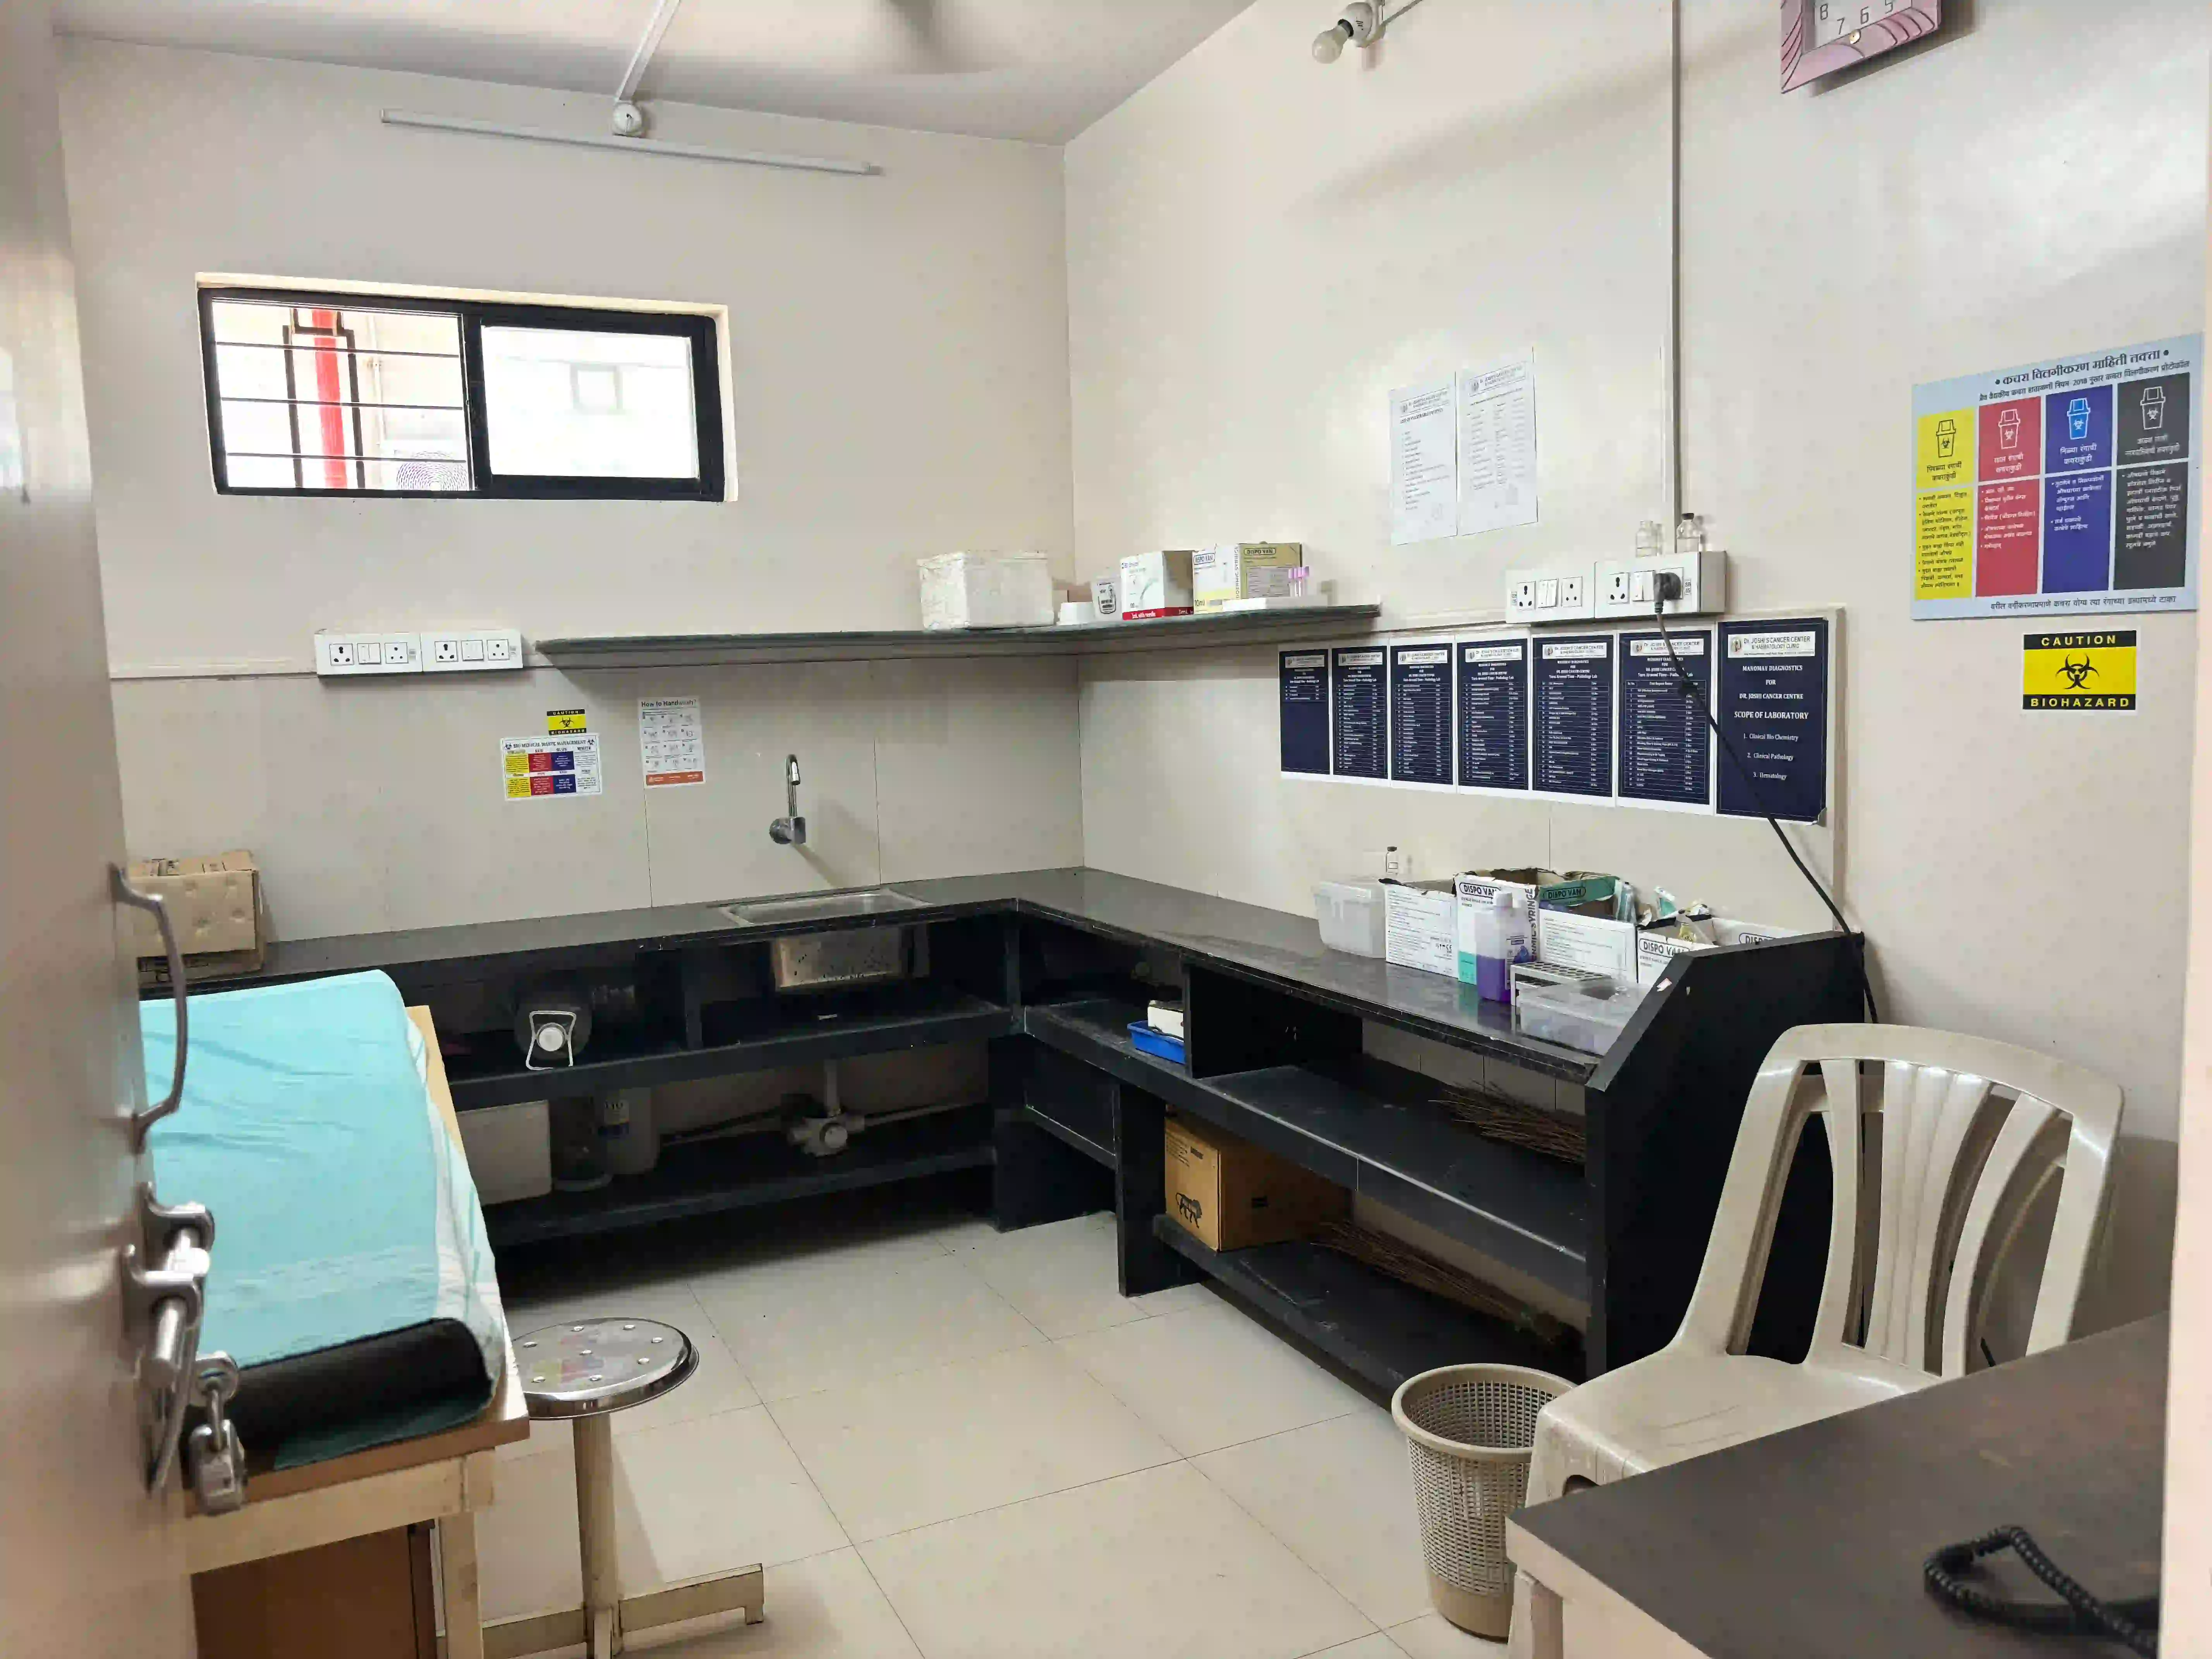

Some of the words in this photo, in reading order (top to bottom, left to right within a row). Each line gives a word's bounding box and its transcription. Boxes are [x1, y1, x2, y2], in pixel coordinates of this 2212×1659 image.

[1820, 3, 1828, 20] 8
[1860, 6, 1869, 24] 6
[1837, 17, 1845, 35] 7
[2003, 373, 2029, 385] कचरा
[2033, 362, 2090, 380] विलगीकरण
[2093, 353, 2127, 369] माहिती
[2130, 350, 2160, 363] तक्ता
[2073, 378, 2087, 386] 2018
[2041, 635, 2116, 646] CAUTION
[2031, 698, 2129, 707] BIOHAZARD
[1771, 753, 1794, 761] Pathology
[1759, 772, 1788, 780] Hematology
[1463, 884, 1481, 894] DISPO
[1549, 891, 1566, 899] DISPO
[1525, 888, 1536, 928] SYRINGE
[1644, 941, 1664, 953] DISPO
